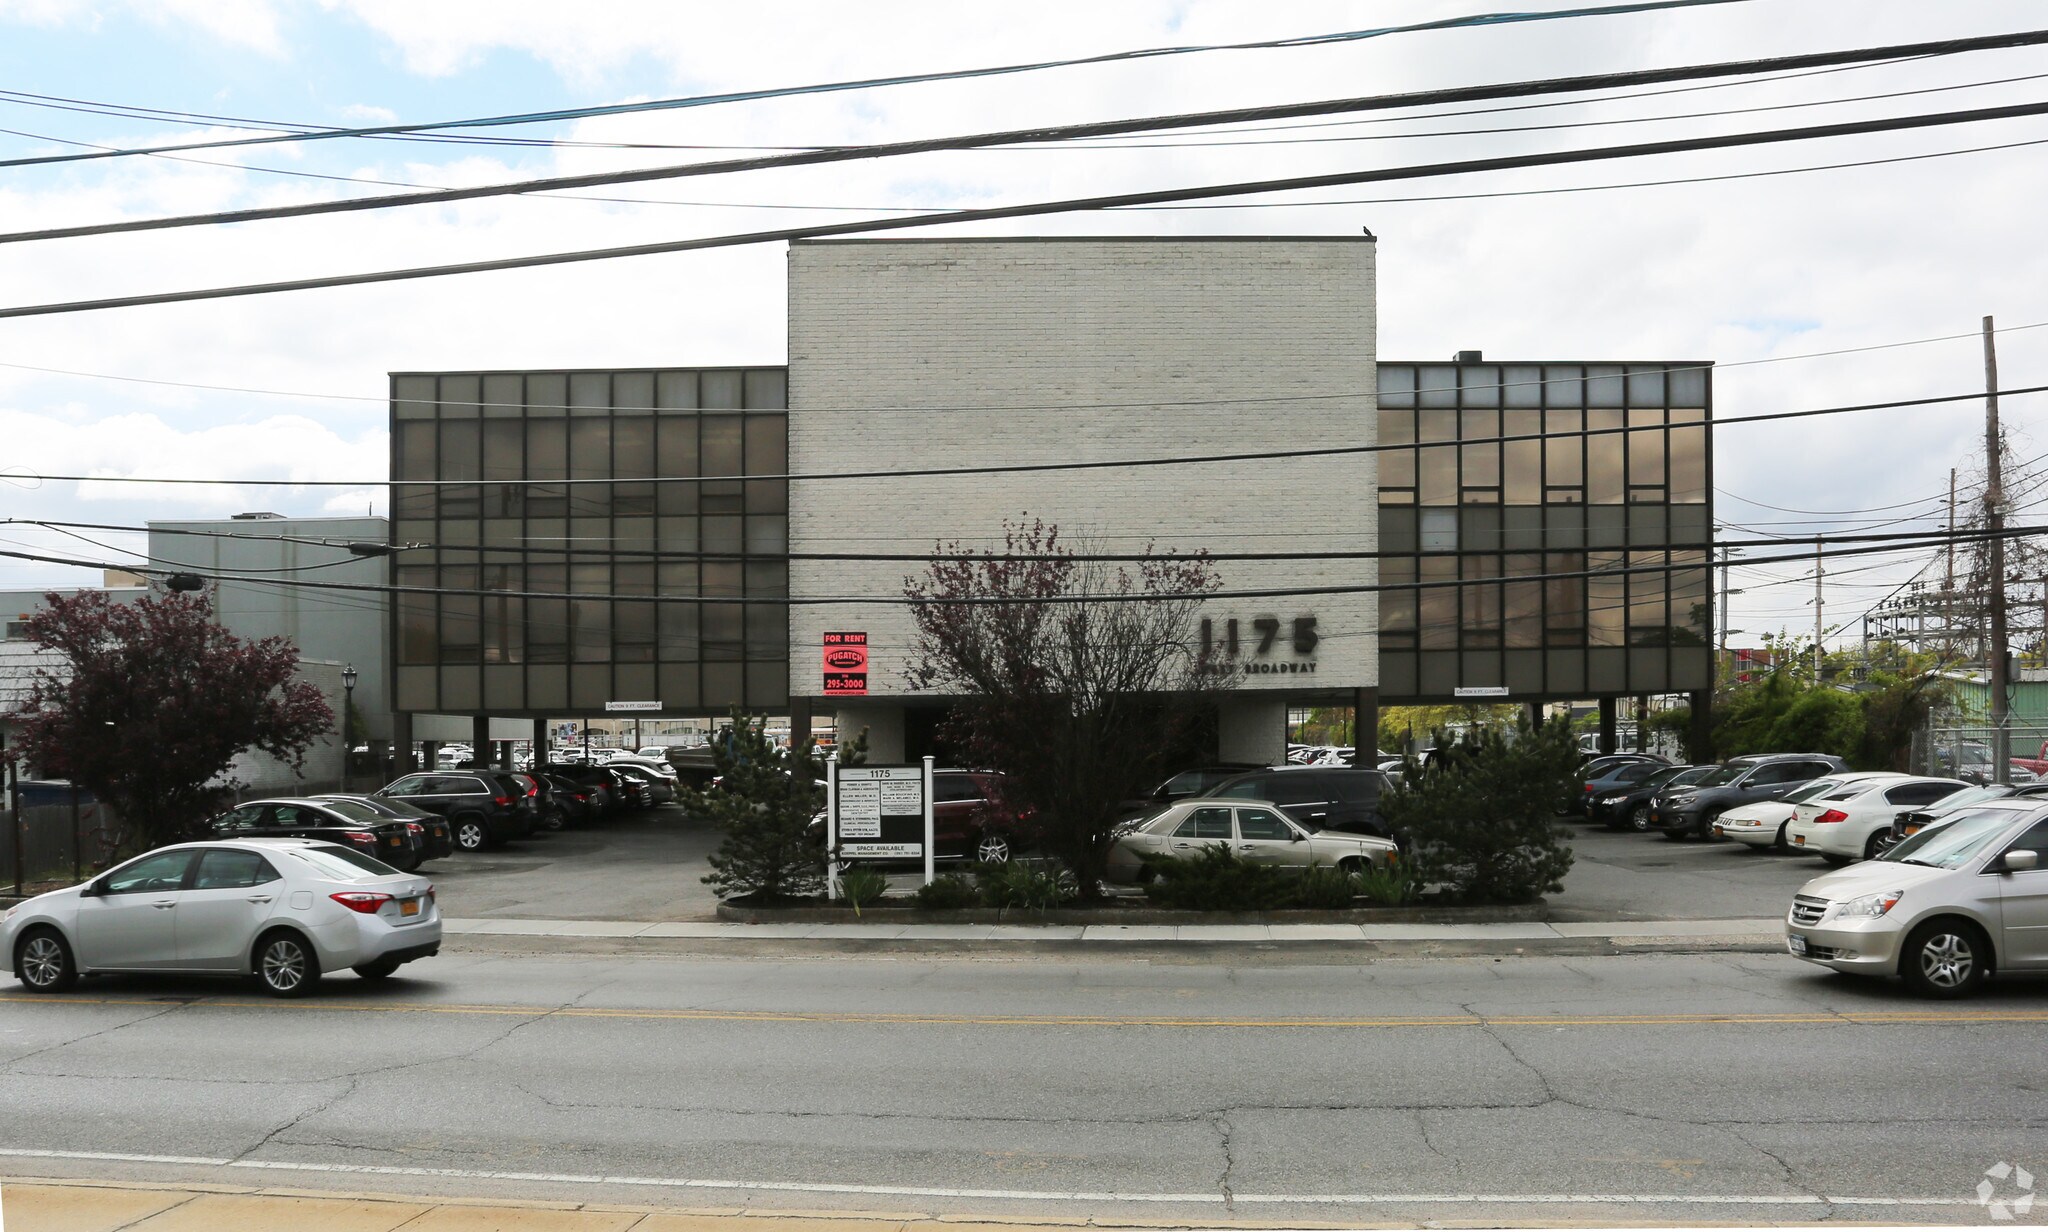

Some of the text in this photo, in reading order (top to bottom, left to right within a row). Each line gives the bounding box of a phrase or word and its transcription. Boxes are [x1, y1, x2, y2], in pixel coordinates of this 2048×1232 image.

[825, 635, 865, 643] FOR RENT
[1201, 617, 1318, 654] 1175
[827, 651, 863, 663] PUGATCH
[1245, 663, 1317, 674] BROADWAY
[826, 679, 864, 688] 295-3000
[870, 769, 891, 778] 1175
